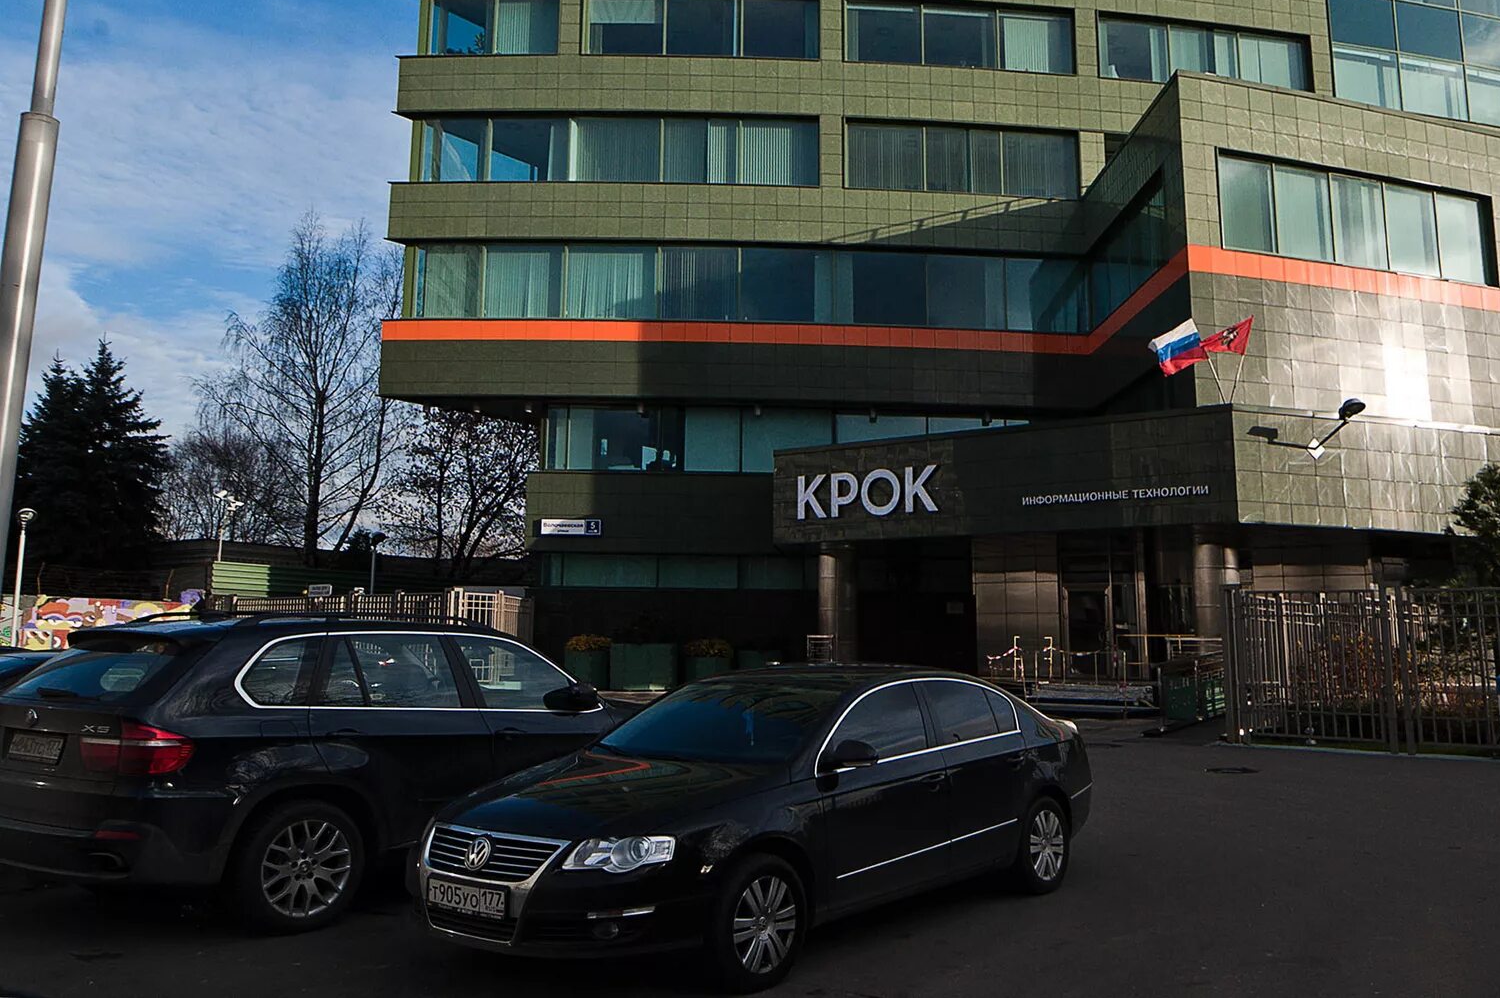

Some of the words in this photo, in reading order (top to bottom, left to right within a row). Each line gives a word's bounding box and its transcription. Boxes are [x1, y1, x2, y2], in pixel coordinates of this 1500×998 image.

[797, 464, 939, 520] КРОК
[1022, 489, 1129, 506] ИНФОРМАЦИОННЫЕ
[1131, 485, 1210, 500] ТЕХНОЛОГИИ
[80, 724, 111, 734] X5
[481, 890, 502, 908] 177
